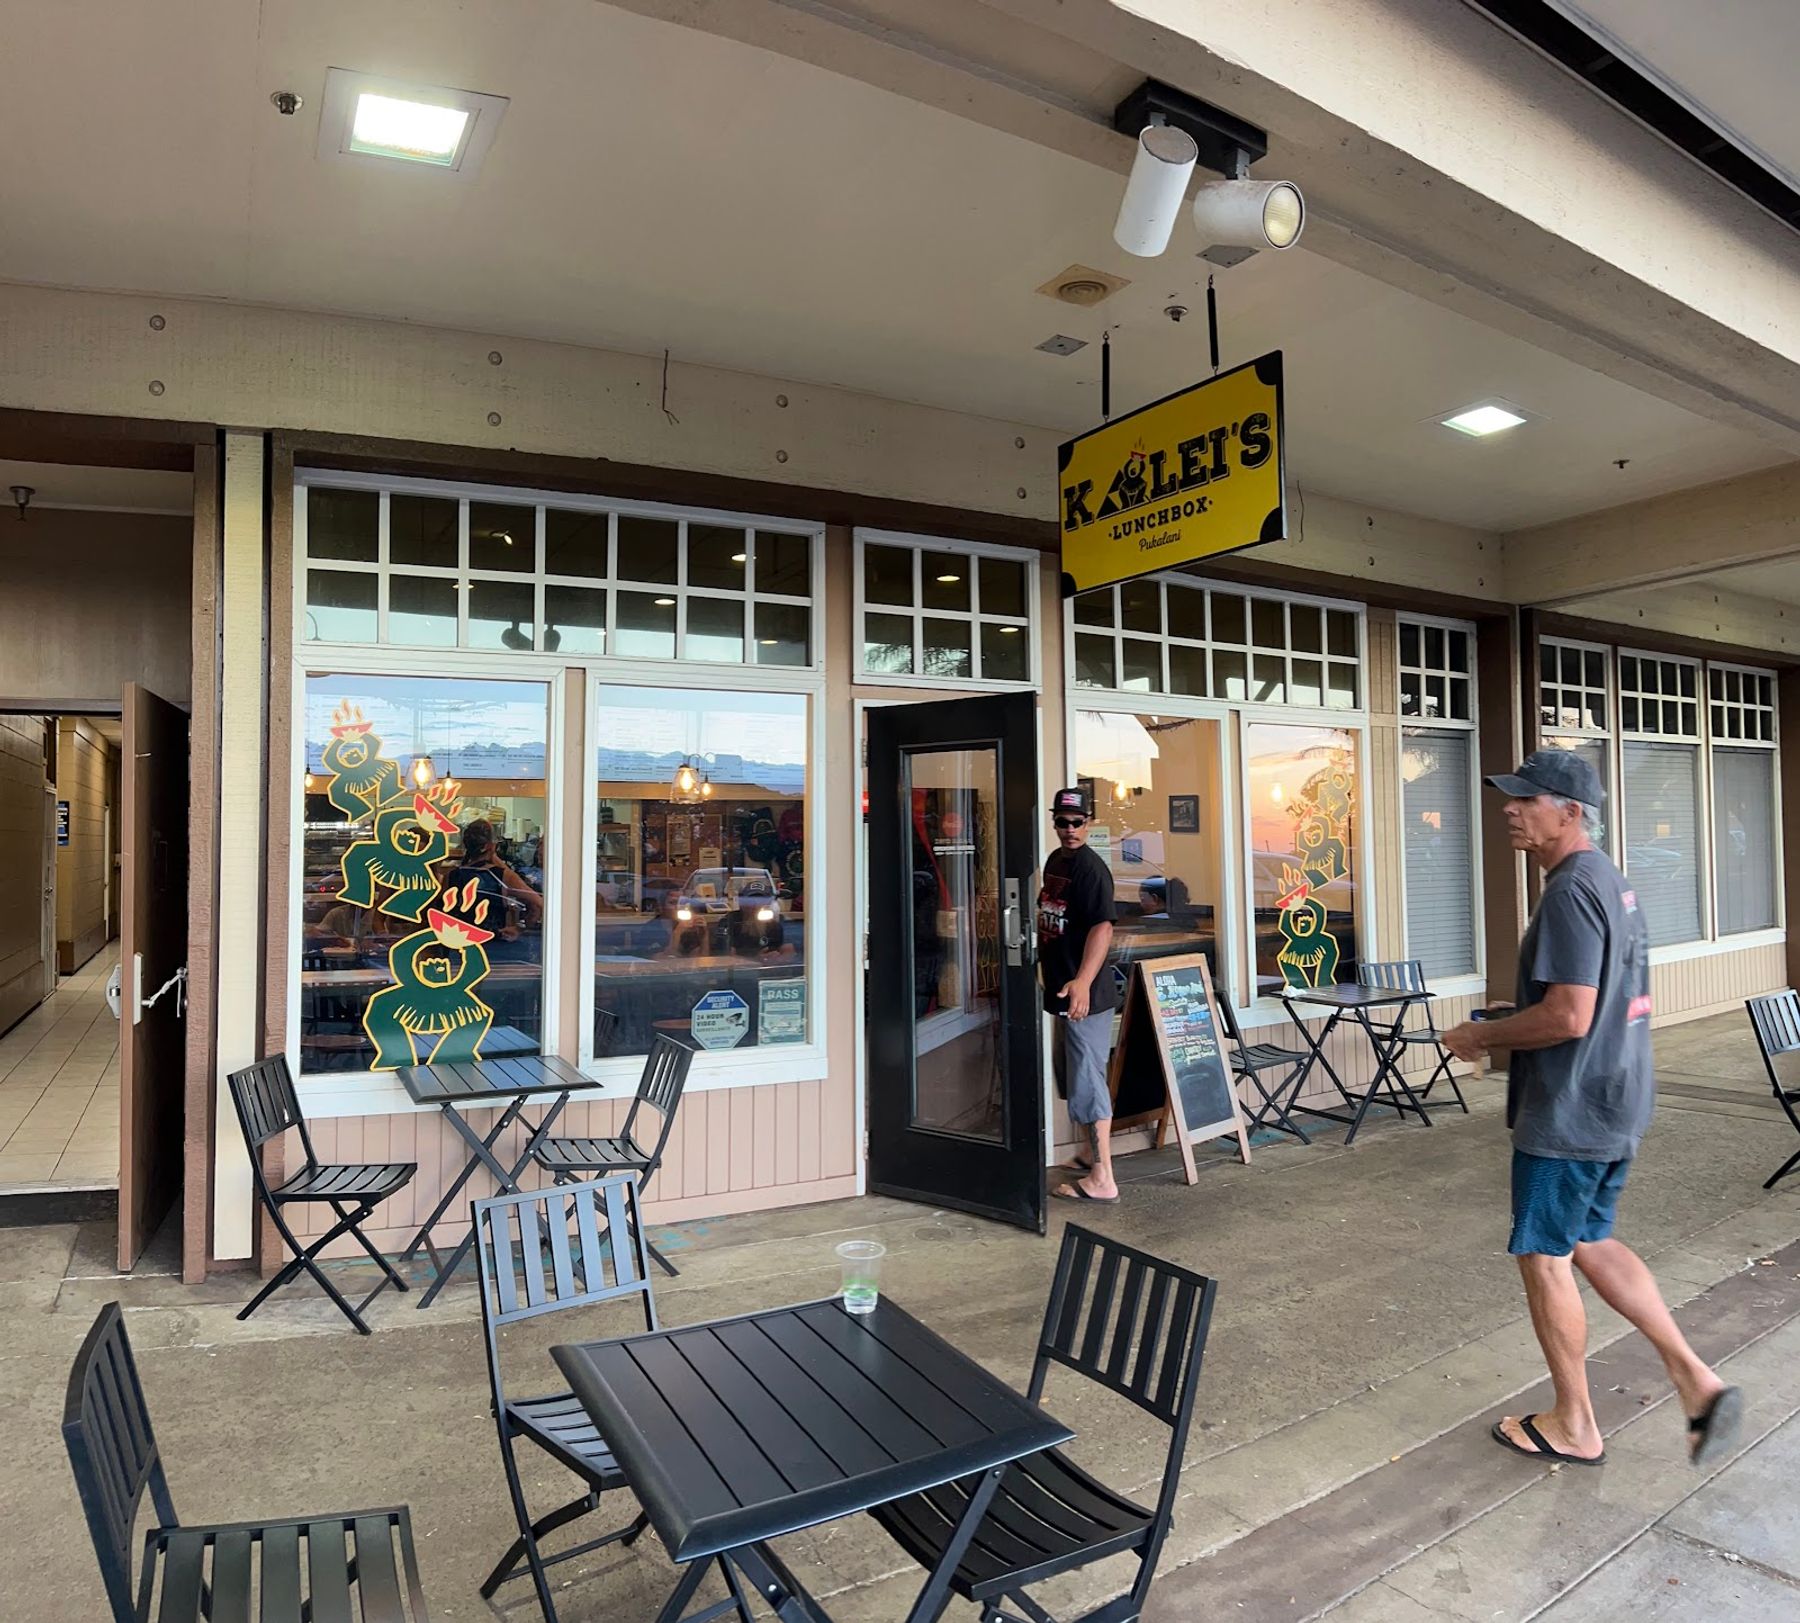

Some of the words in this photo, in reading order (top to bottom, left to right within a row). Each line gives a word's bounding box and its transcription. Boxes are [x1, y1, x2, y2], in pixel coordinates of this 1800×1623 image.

[1064, 412, 1272, 532] KALEI'S
[1112, 496, 1208, 540] LUNCHBOX
[1138, 529, 1181, 551] Pukalani
